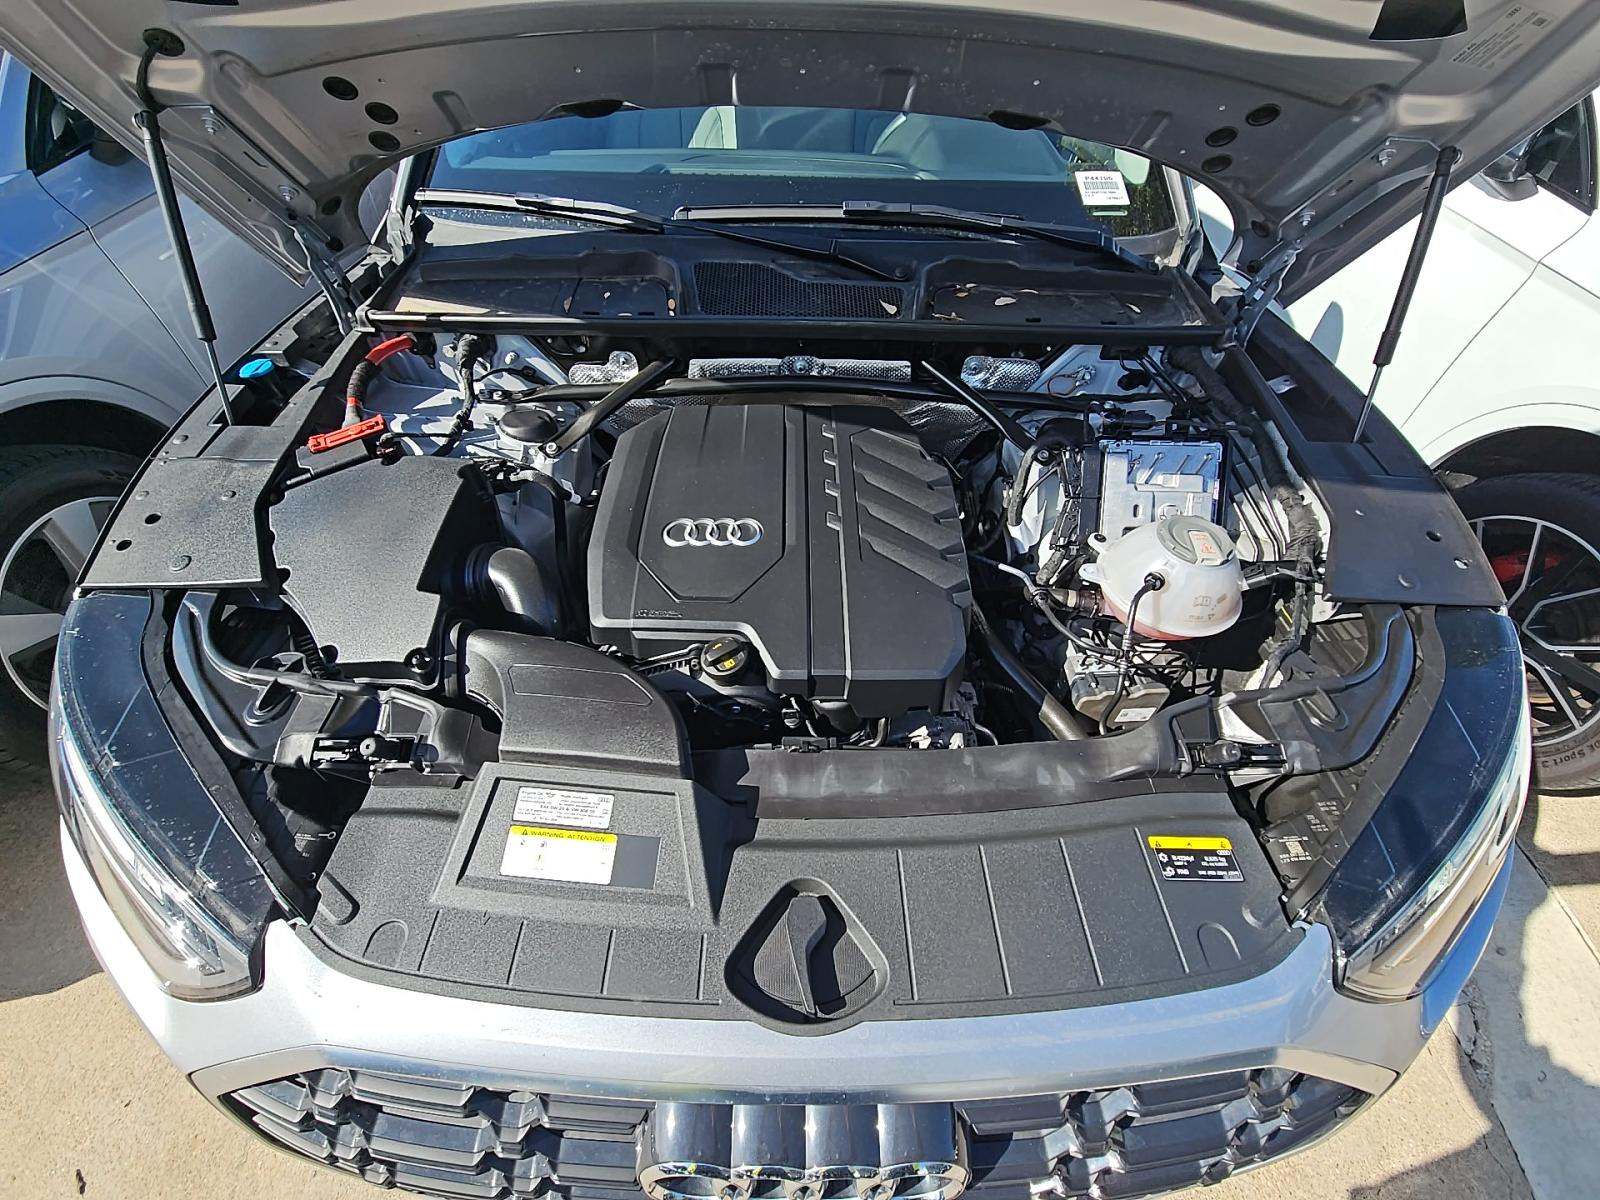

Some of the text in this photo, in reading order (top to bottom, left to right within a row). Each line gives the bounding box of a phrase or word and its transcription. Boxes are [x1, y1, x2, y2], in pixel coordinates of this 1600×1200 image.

[1553, 749, 1586, 766] Sport
[1541, 760, 1550, 769] 3
[530, 830, 607, 843] WARNING ATTENTION
